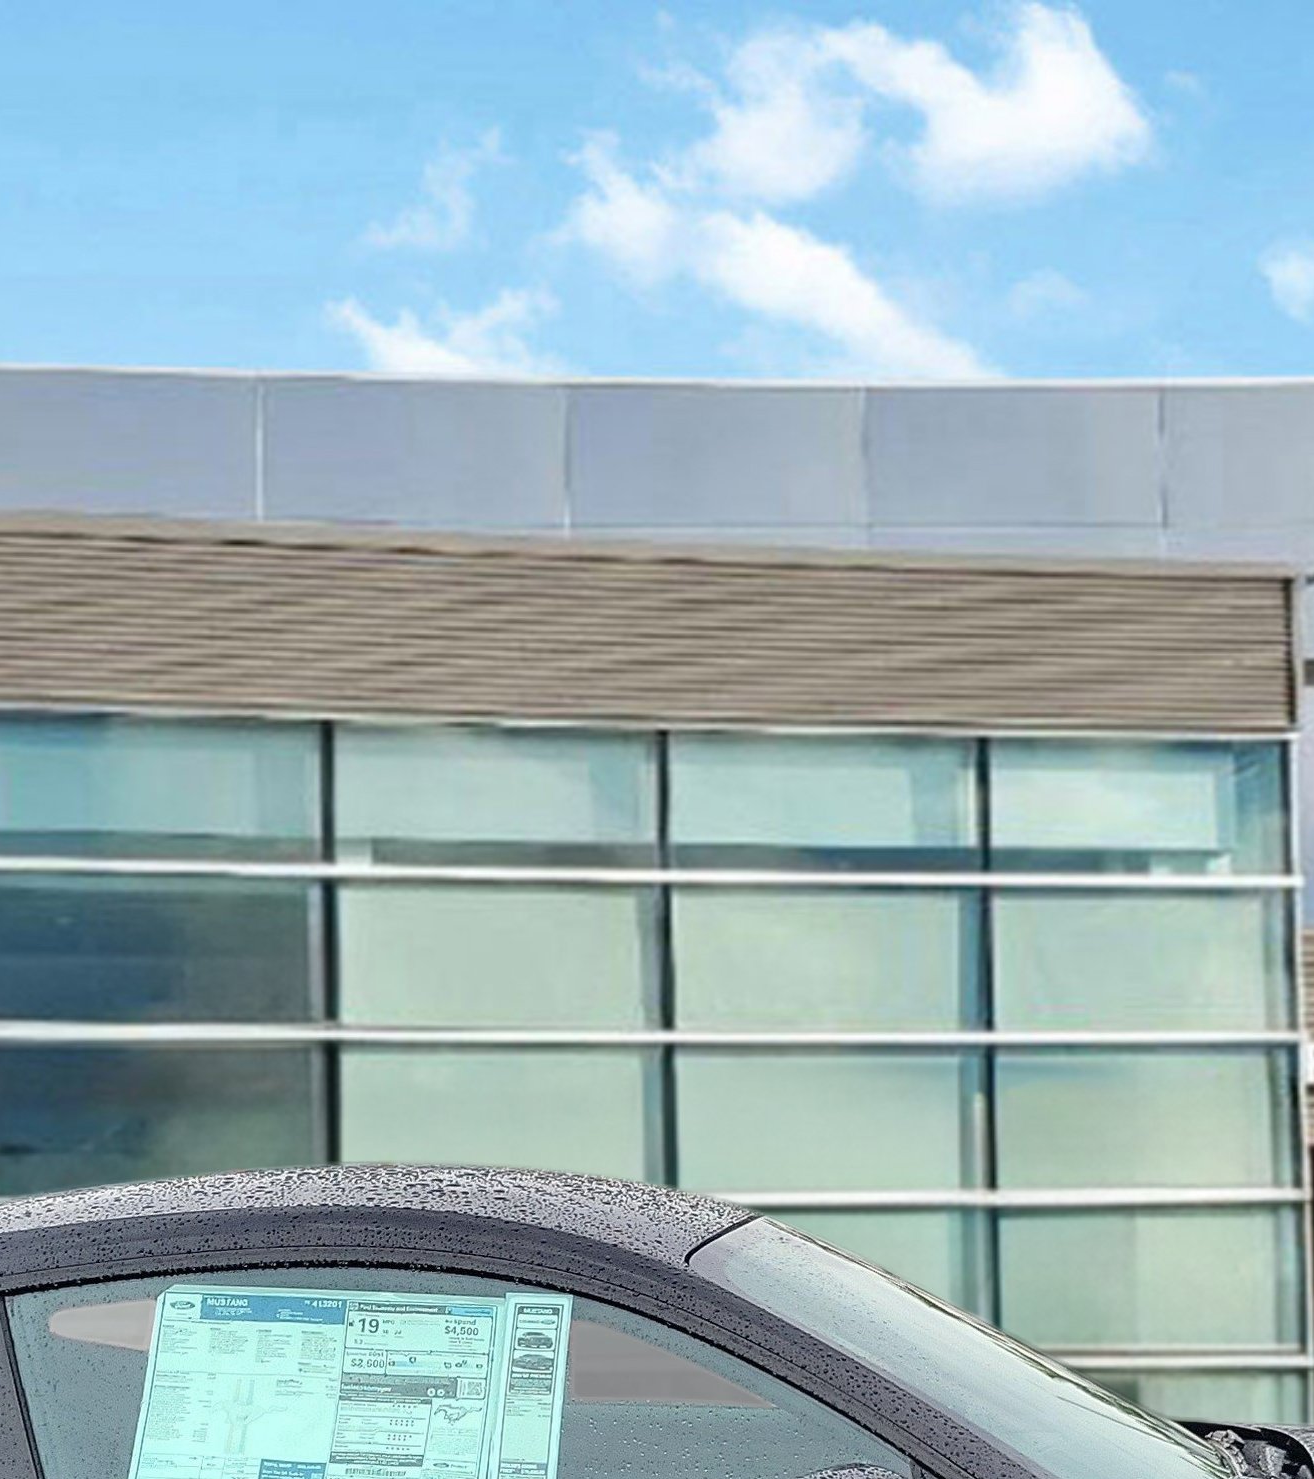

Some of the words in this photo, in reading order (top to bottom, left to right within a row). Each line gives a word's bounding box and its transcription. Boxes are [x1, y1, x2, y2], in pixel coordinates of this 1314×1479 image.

[206, 1297, 249, 1307] MUSTANG
[358, 1317, 380, 1334] 19
[444, 1325, 479, 1336] $4,500
